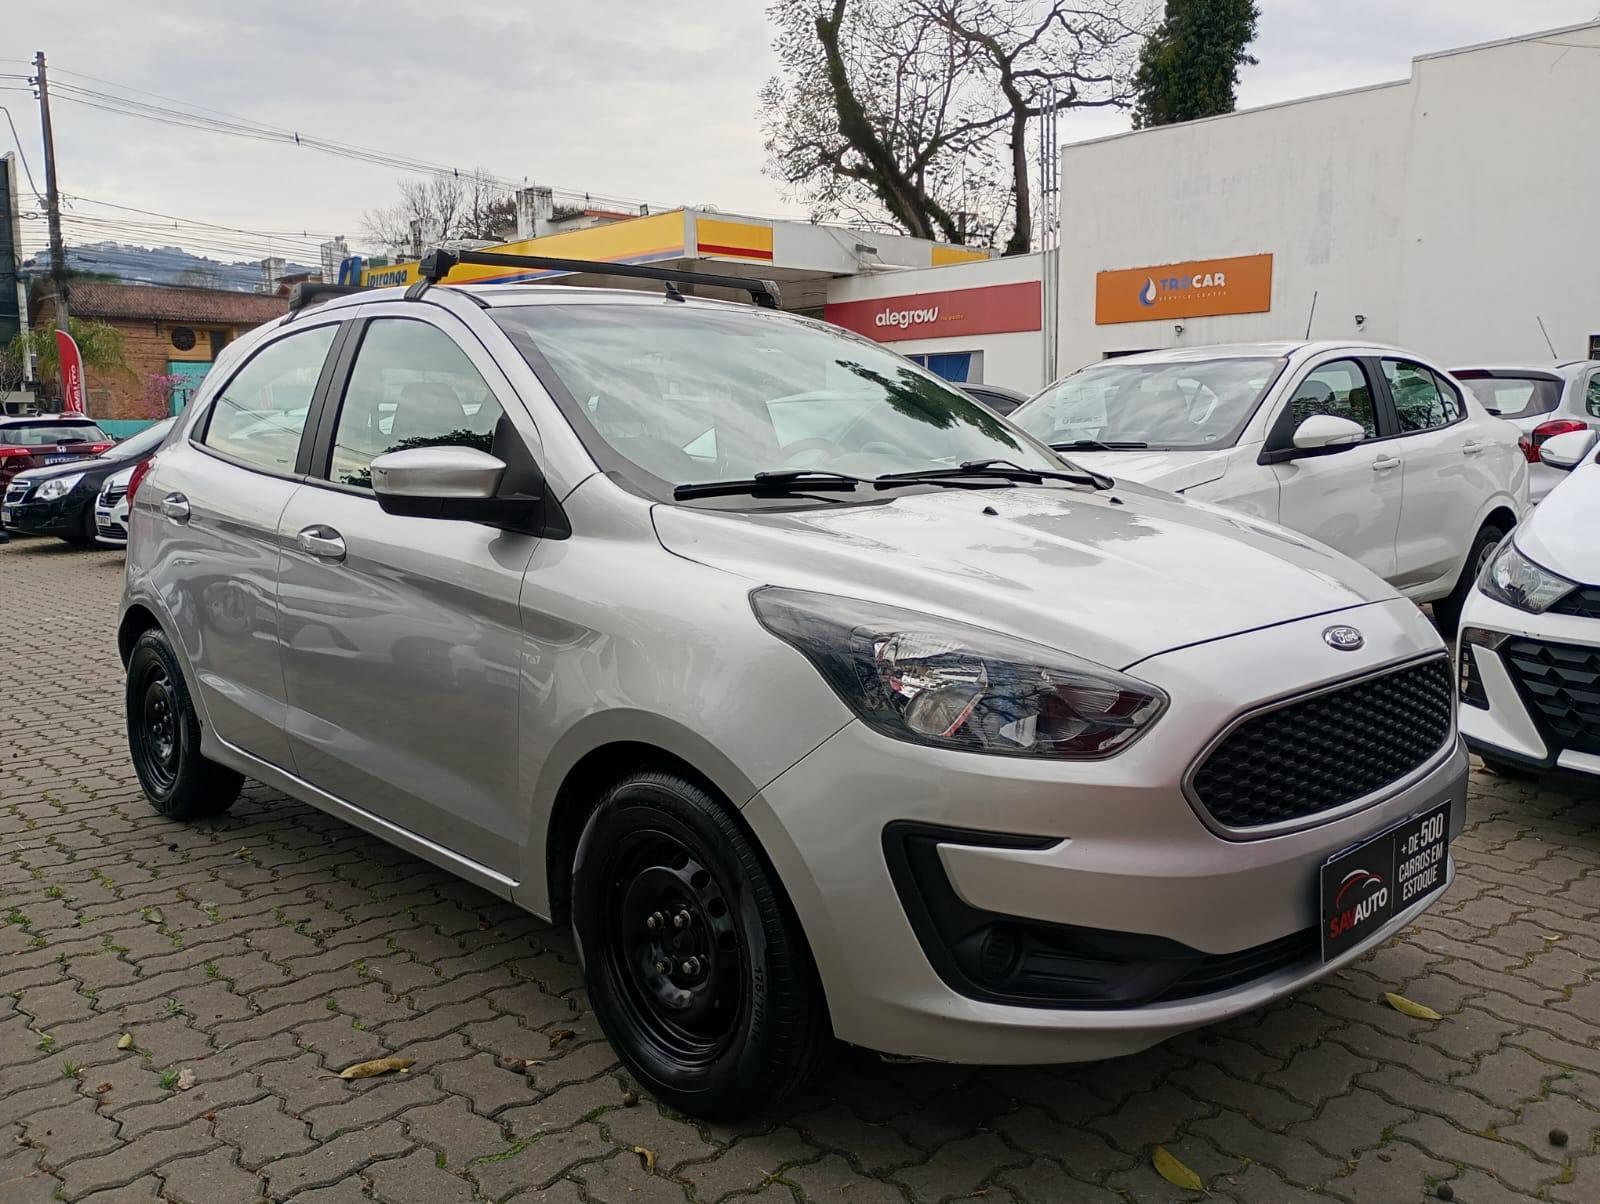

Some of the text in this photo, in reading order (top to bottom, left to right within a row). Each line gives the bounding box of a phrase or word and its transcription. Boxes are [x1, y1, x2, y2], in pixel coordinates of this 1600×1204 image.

[1160, 273, 1226, 291] TROCAR
[875, 306, 938, 328] alegrow
[1334, 629, 1358, 643] Ford
[1408, 833, 1420, 854] DE
[1420, 812, 1444, 847] 500
[1399, 841, 1444, 883] CARROS EM
[1403, 865, 1438, 901] ESTOQUE
[1330, 887, 1388, 938] SAVAUTO
